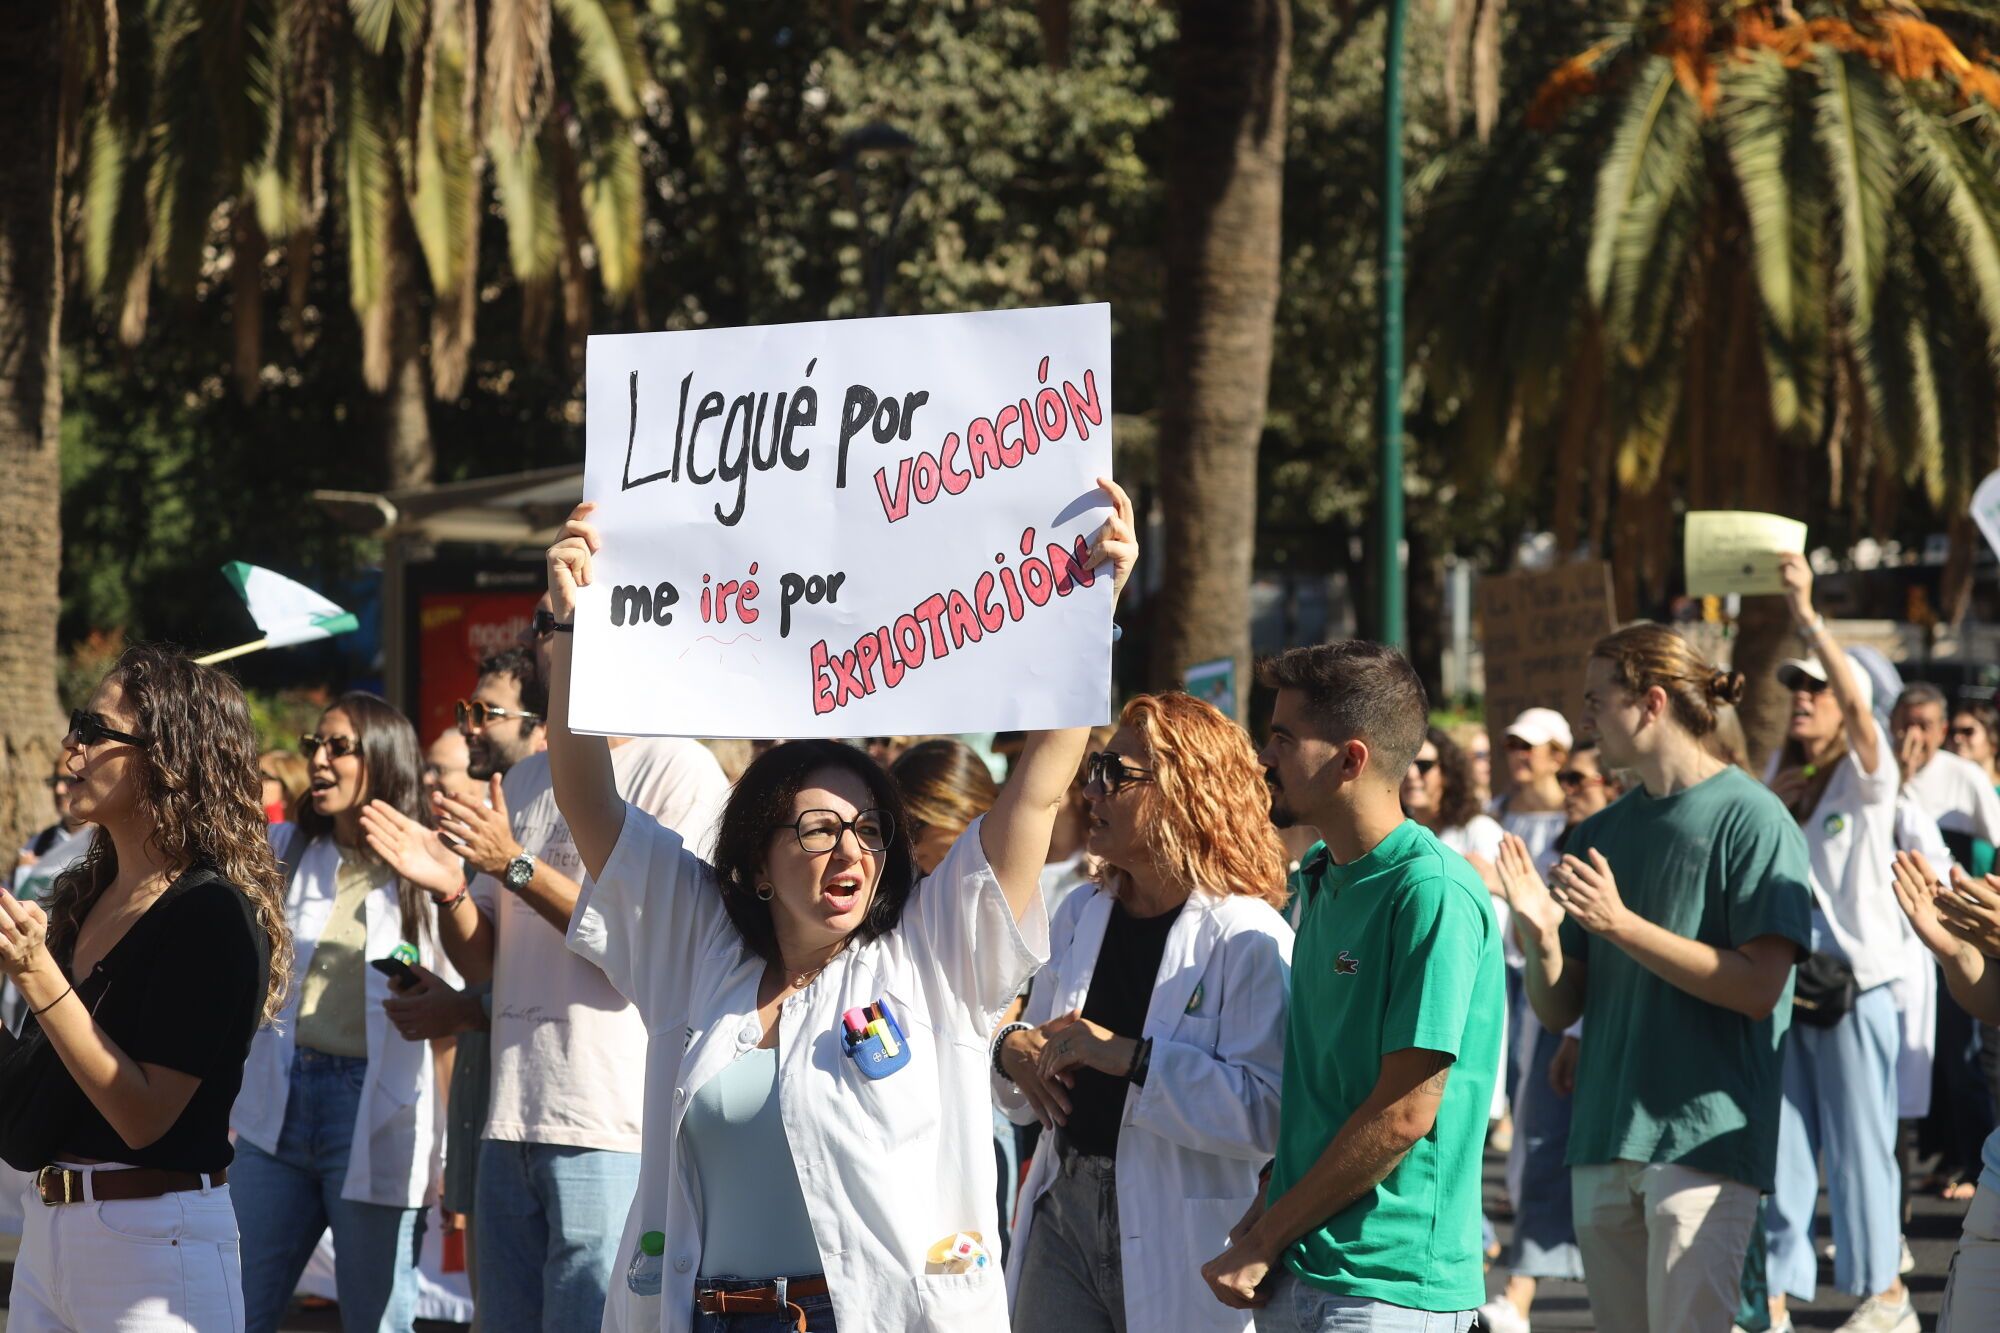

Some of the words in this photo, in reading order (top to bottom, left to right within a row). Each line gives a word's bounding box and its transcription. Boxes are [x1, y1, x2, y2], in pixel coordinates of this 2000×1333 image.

[621, 357, 818, 526] Llegué
[836, 384, 930, 488] por
[875, 356, 1104, 523] VOCACIÓN
[611, 580, 680, 628] me
[700, 562, 760, 624] iré
[780, 571, 846, 639] por
[811, 527, 1097, 716] EXPLOTACIÓN
